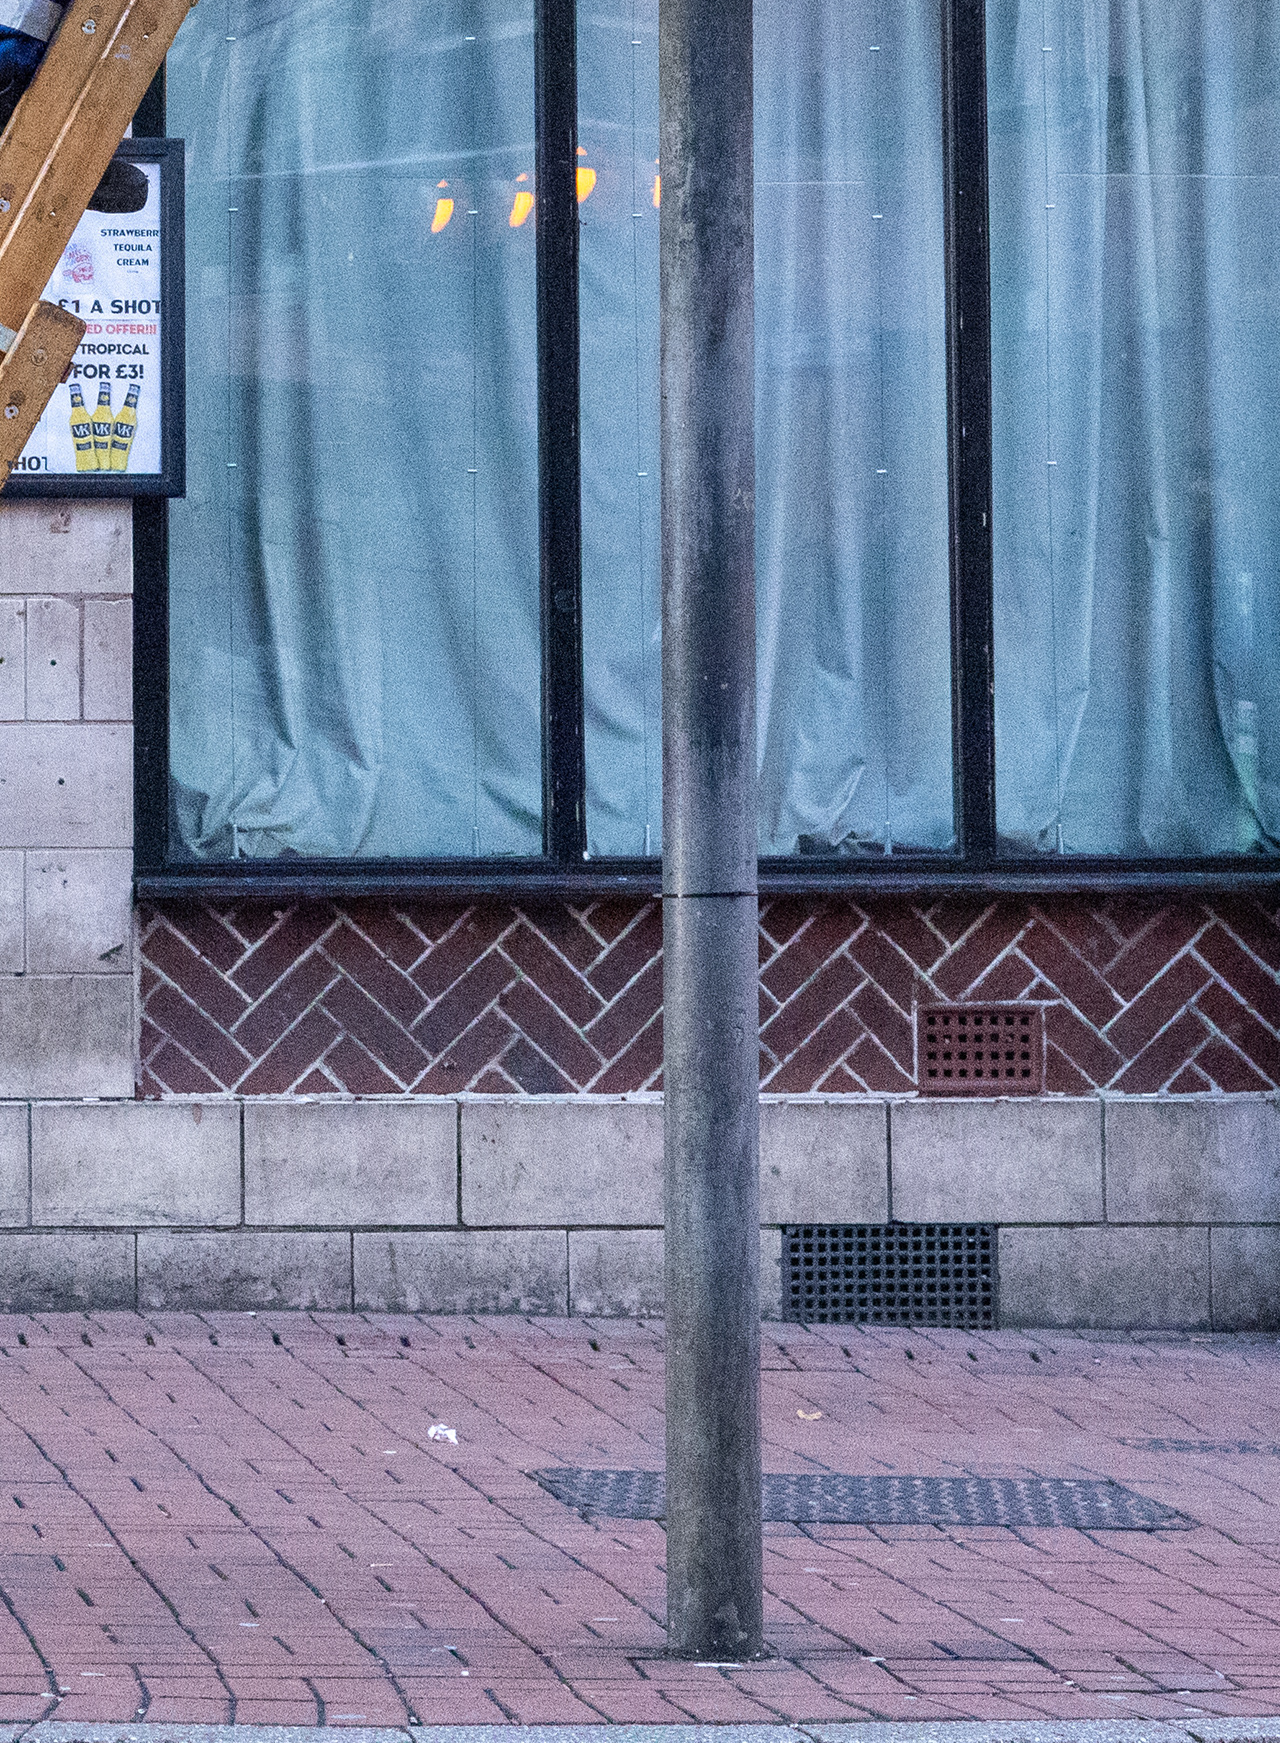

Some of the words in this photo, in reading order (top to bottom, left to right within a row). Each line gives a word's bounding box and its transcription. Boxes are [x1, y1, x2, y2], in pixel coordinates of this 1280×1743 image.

[100, 229, 161, 237] STRAWBERR
[113, 243, 153, 252] TEQUILA
[116, 258, 149, 266] CREAM
[90, 300, 104, 313] A
[105, 324, 157, 335] OFFER!!!
[80, 343, 150, 355] TROPICAL
[73, 364, 111, 379] FOR
[115, 364, 144, 379] £3!
[73, 424, 91, 437] VK
[93, 423, 111, 436] VK
[115, 422, 133, 437] VK
